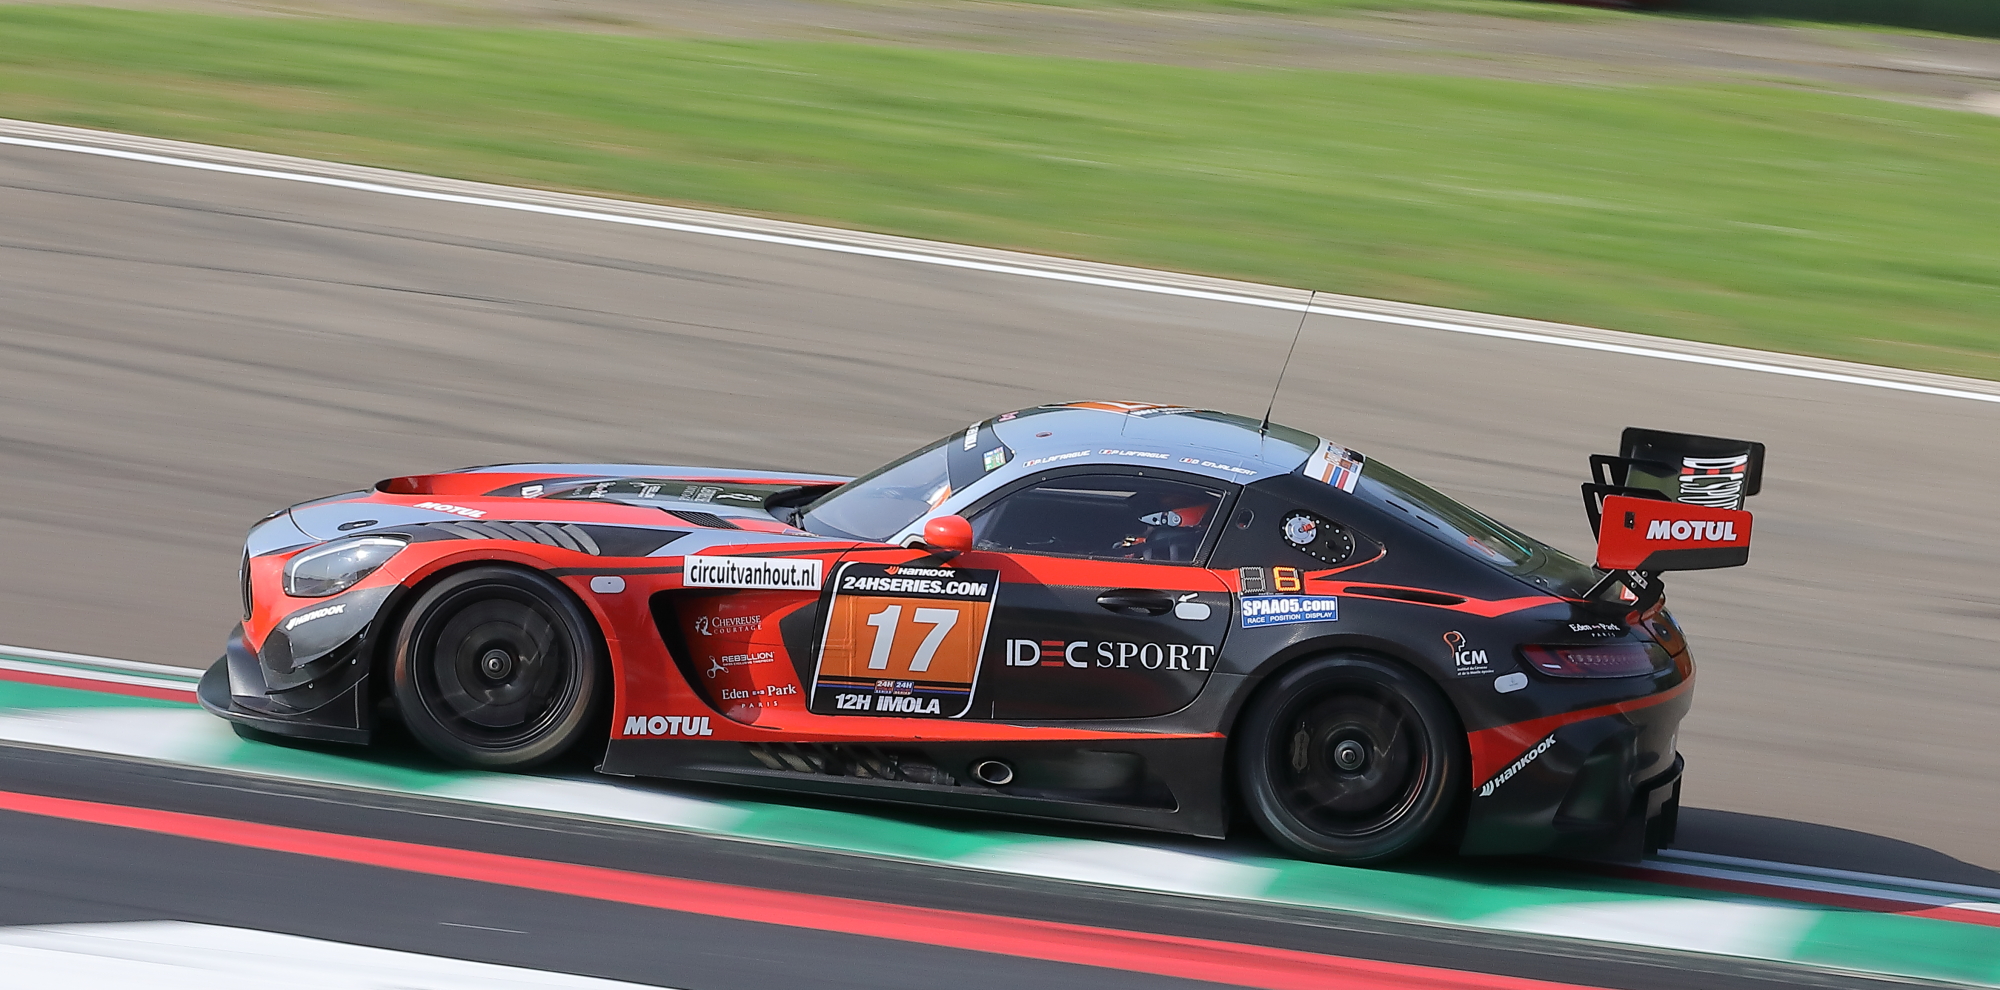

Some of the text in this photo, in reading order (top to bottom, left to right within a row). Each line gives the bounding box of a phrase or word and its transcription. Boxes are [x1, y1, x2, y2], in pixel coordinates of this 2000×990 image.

[1677, 480, 1743, 511] SPO
[413, 501, 487, 519] MOTUL
[1645, 520, 1737, 541] MOTUL
[690, 558, 815, 587] circuitvanhout.nl
[842, 576, 988, 596] 24HSERIES.COM
[1247, 611, 1333, 624] RACE POSITION DISPLAY
[713, 624, 763, 635] COURTAGE
[1568, 622, 1621, 632] Eden Park
[866, 604, 960, 672] 17
[1006, 638, 1215, 672] IDEC SPORT
[1455, 649, 1488, 667] ICM
[722, 683, 797, 700] Eden Park
[876, 680, 894, 688] 24H
[895, 681, 913, 689] 24H
[741, 700, 779, 709] PARIS
[835, 693, 941, 715] 12H IMOLA
[623, 715, 714, 736] MOTUL
